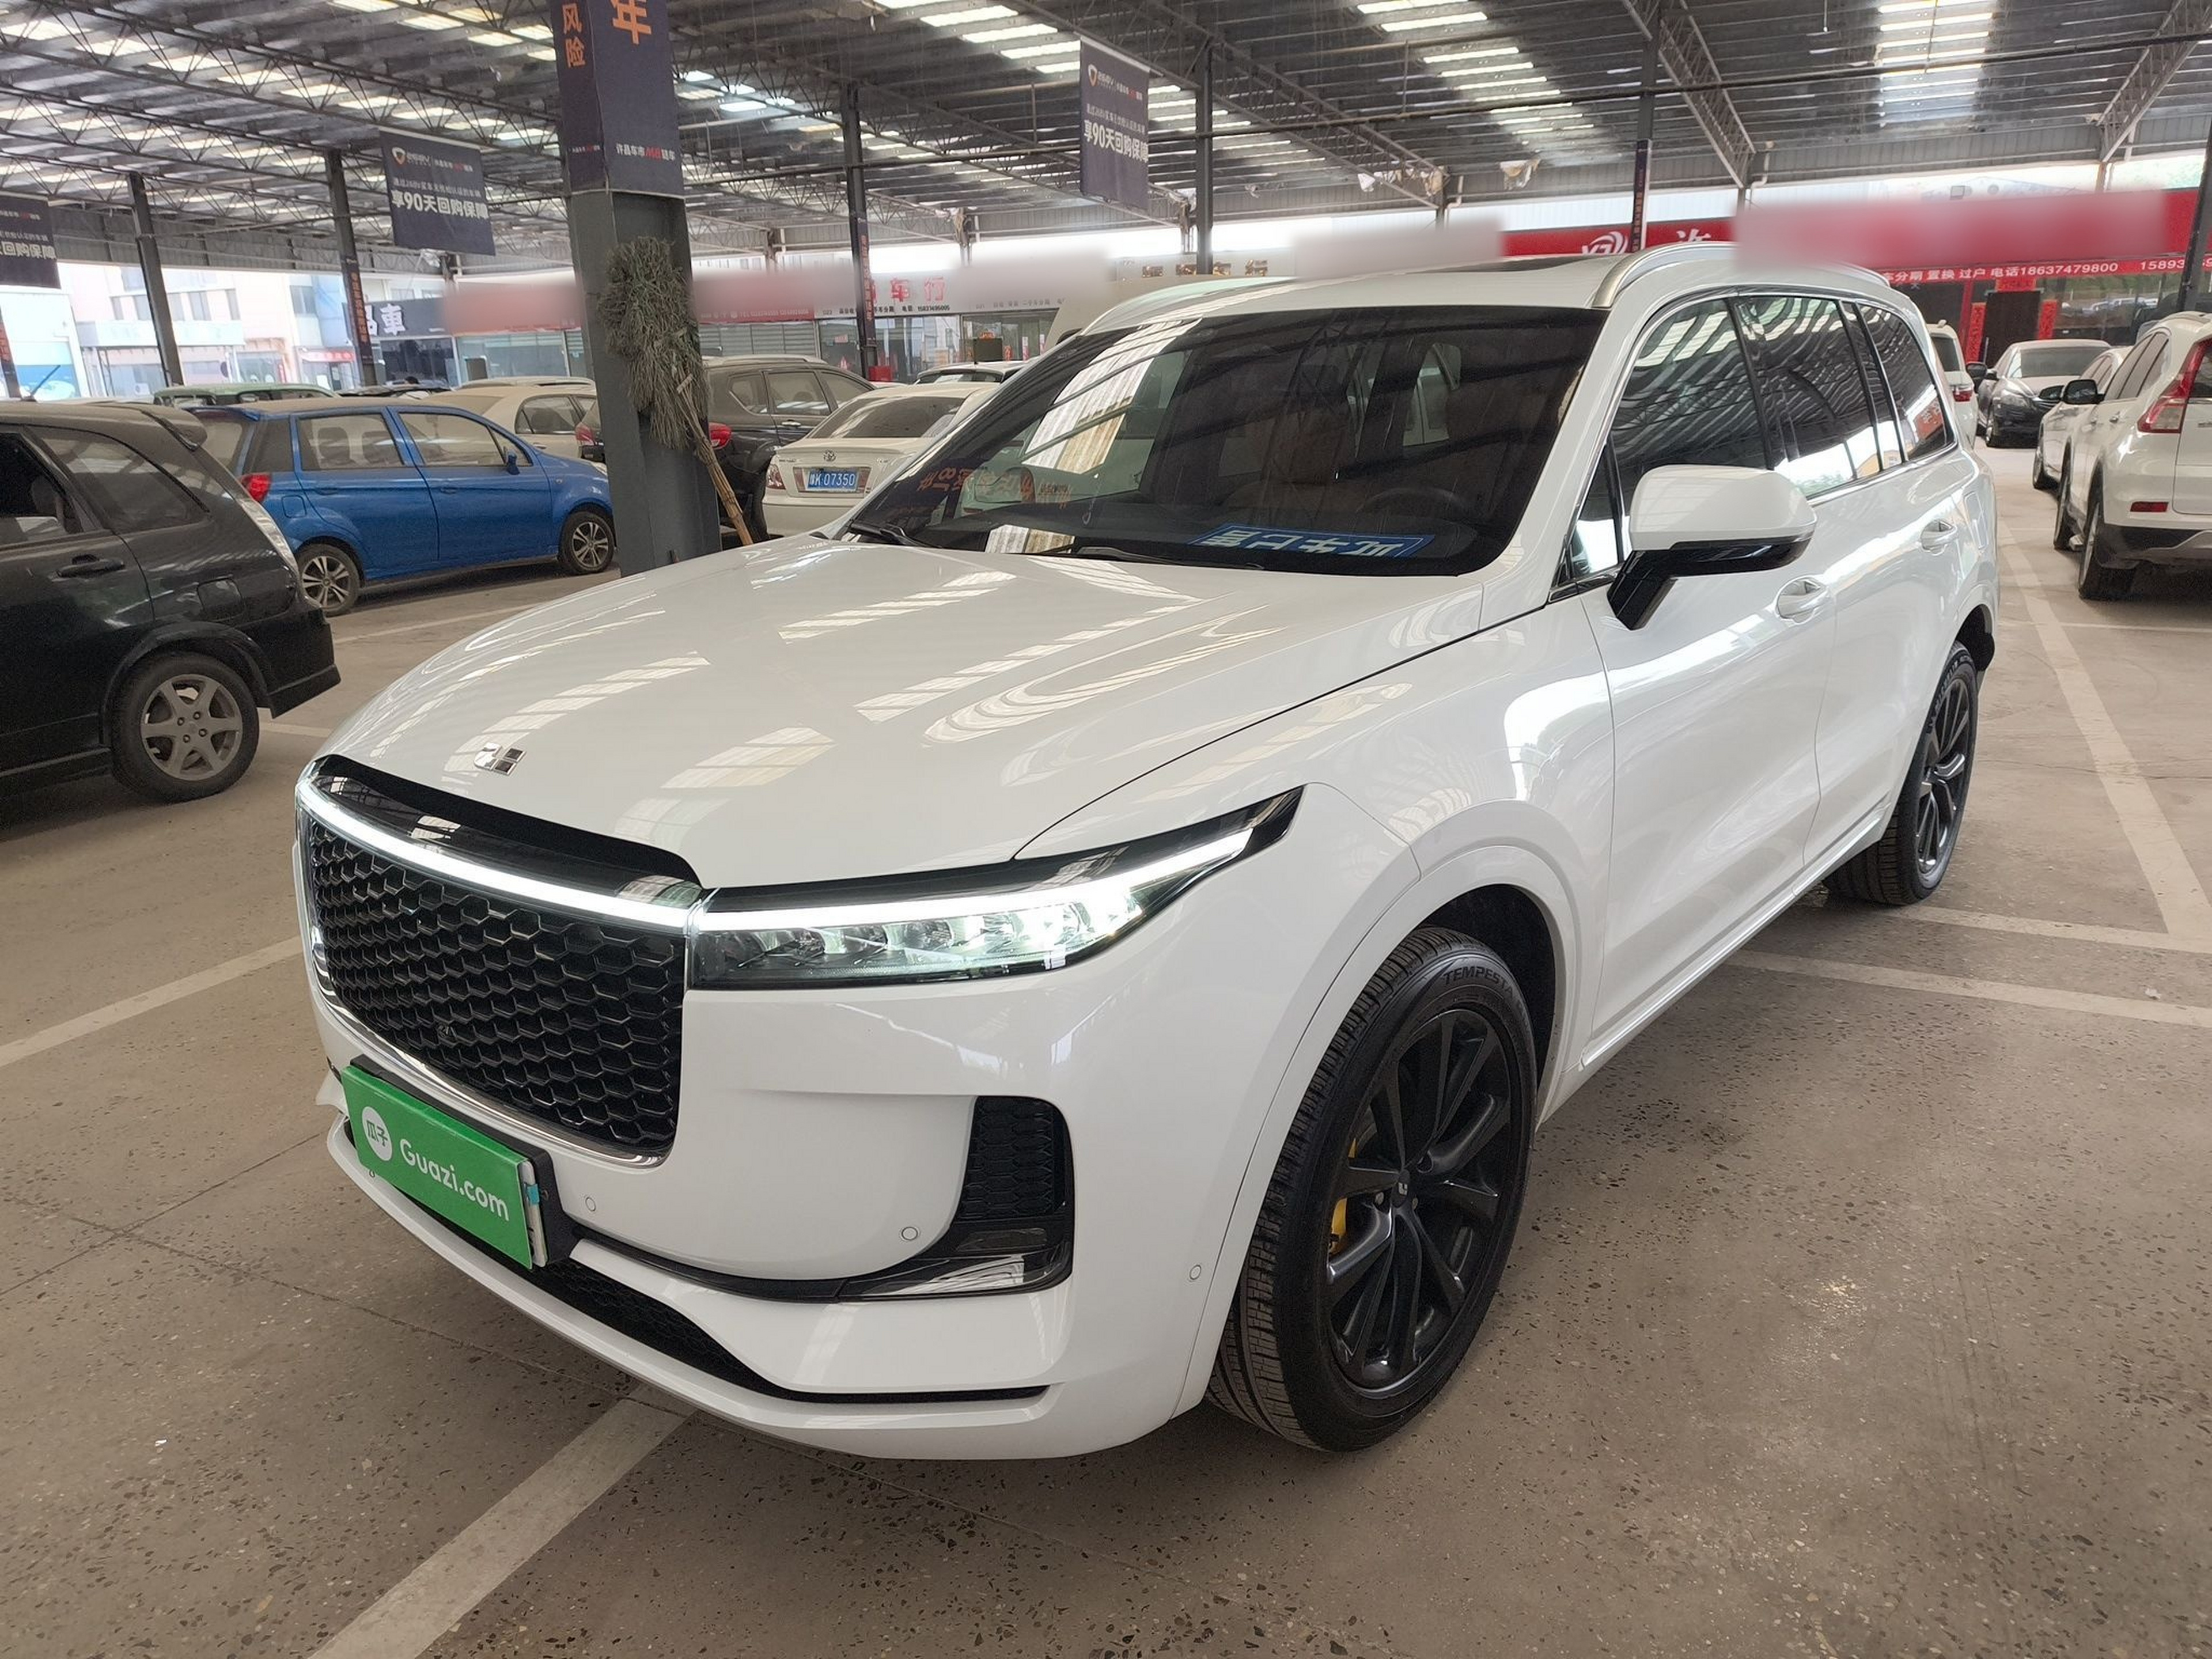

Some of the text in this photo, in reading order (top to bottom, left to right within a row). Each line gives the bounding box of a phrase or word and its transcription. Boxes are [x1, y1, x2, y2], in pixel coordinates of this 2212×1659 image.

[562, 3, 585, 68] 风险
[610, 0, 652, 44] 年
[1084, 119, 1149, 163] 享90天回购保障
[391, 190, 489, 219] 享90天回购保障
[0, 241, 56, 260] 回购保障
[1960, 268, 1986, 278] 过户
[1443, 966, 1513, 998] TEMPESTA
[366, 1120, 388, 1147] 瓜子
[399, 1138, 510, 1222] Guazi.com
